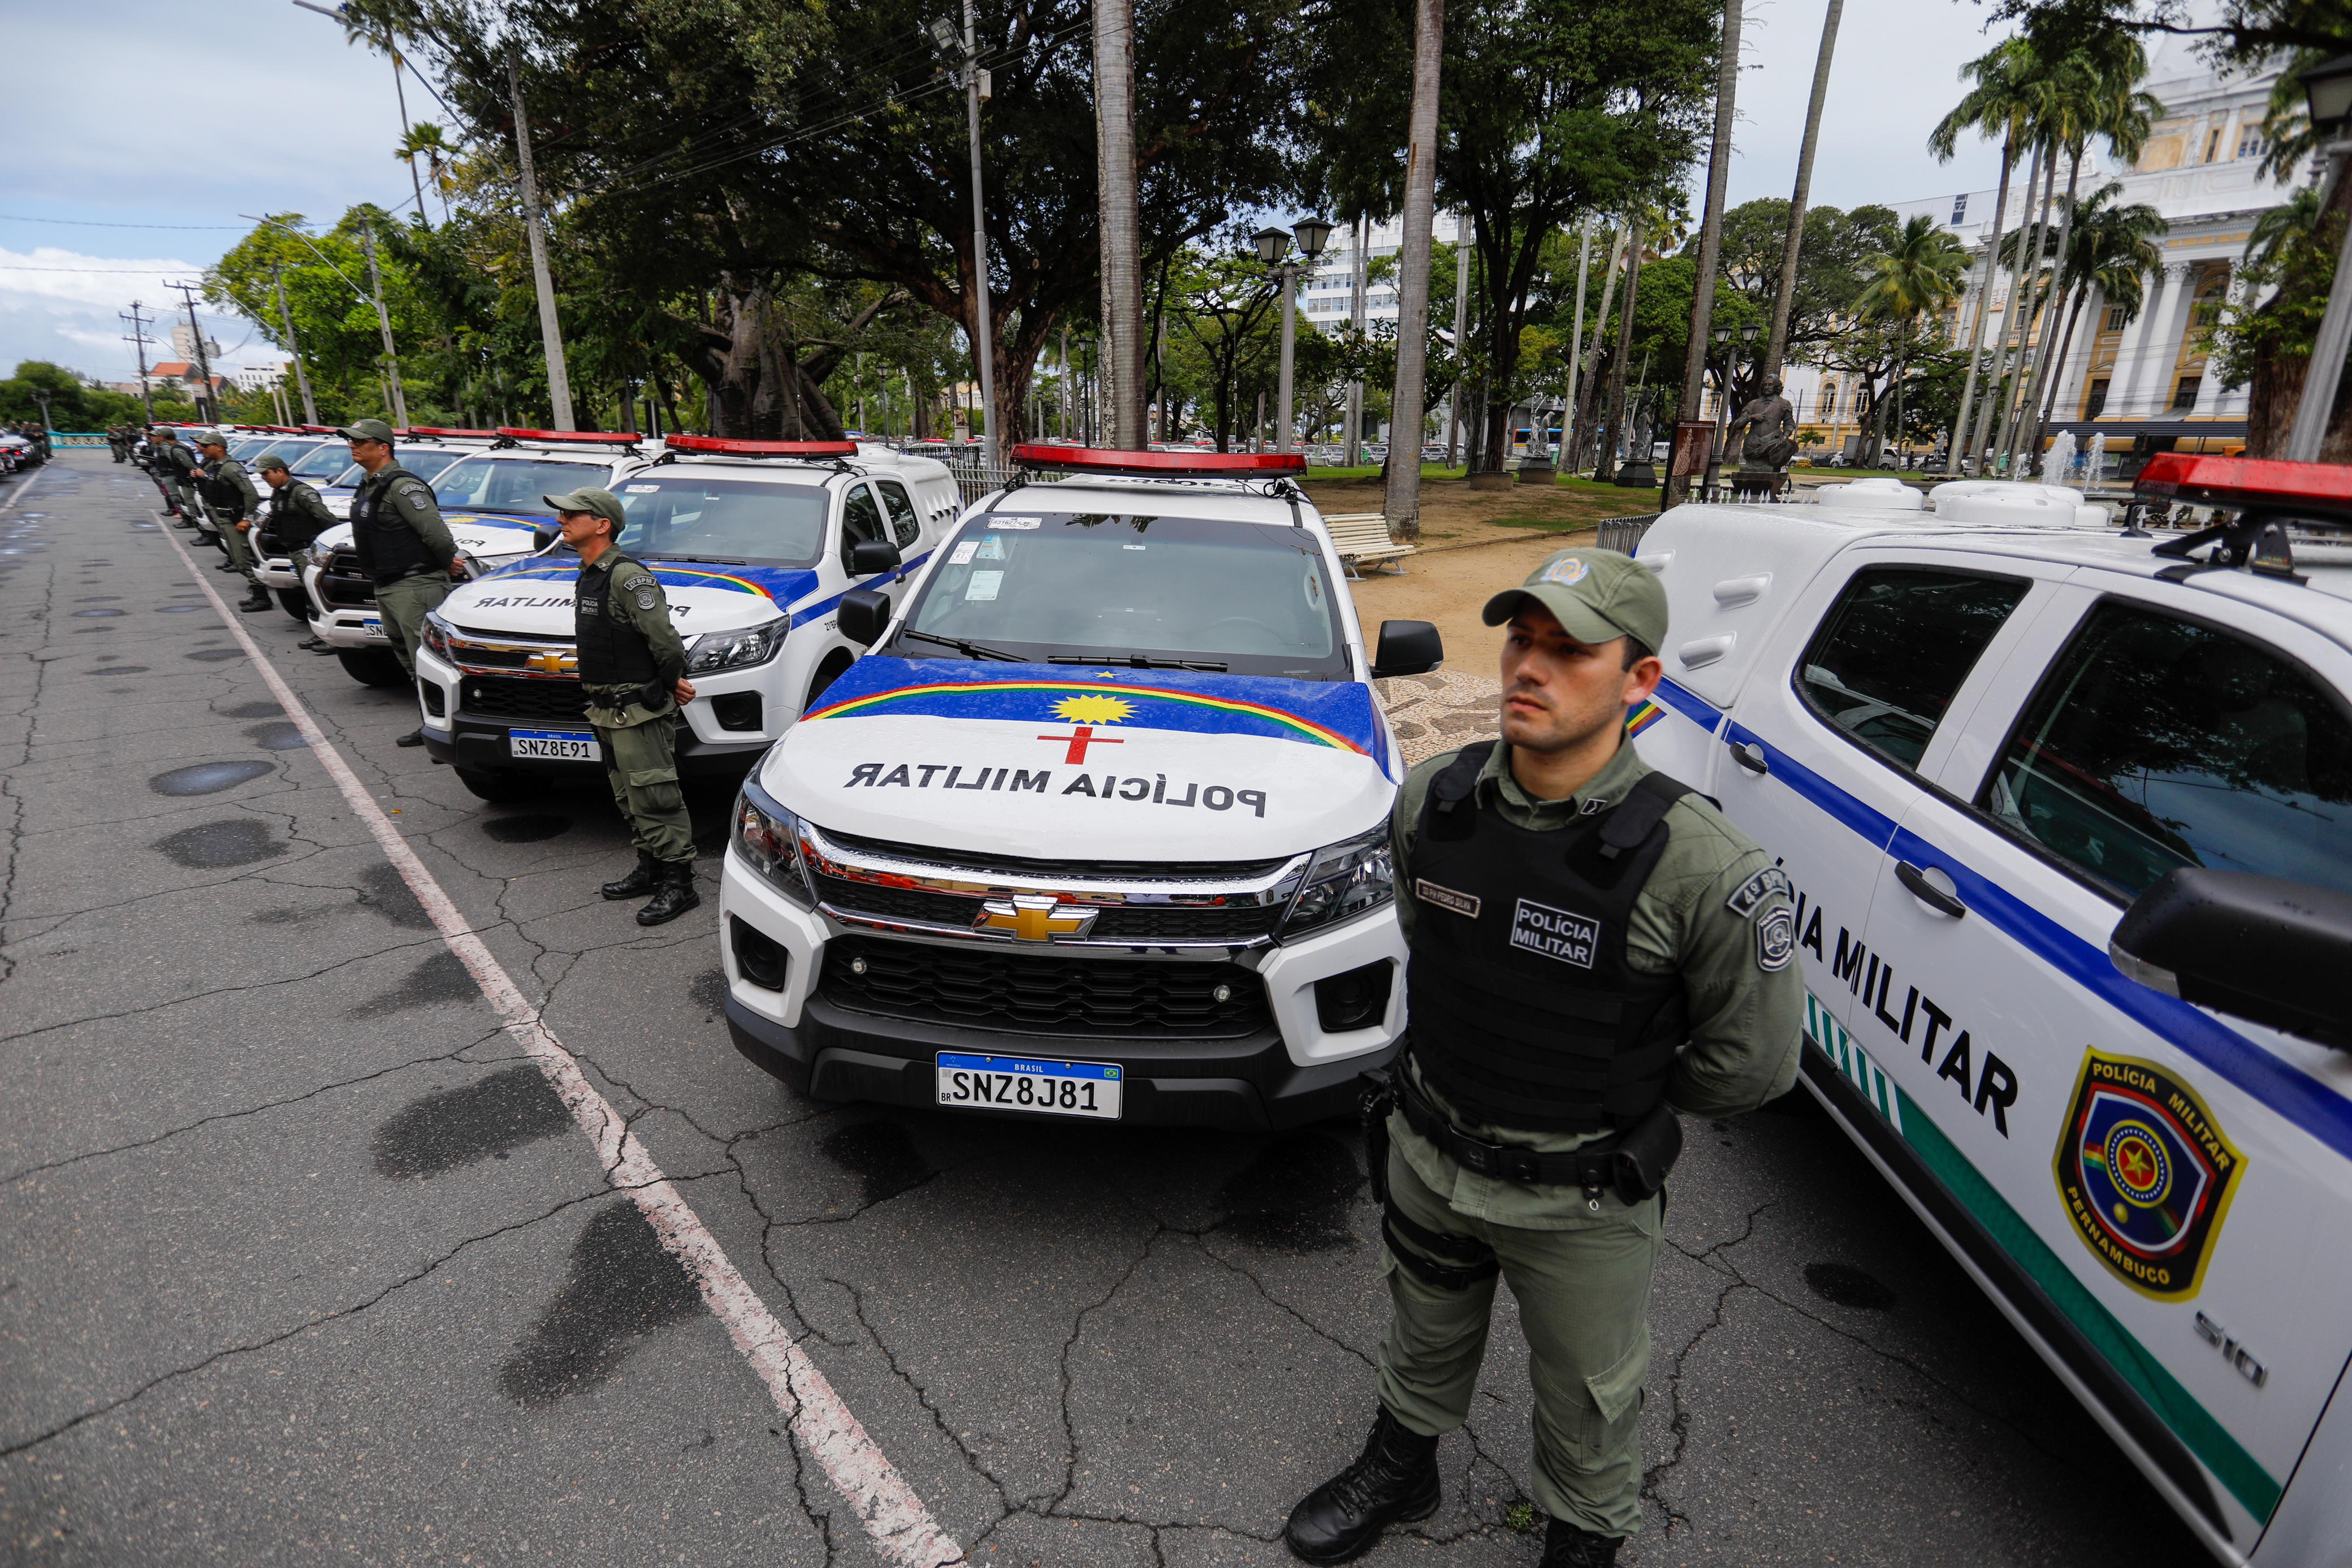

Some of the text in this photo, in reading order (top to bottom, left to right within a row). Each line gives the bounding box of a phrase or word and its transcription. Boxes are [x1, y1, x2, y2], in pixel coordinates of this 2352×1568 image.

[628, 579, 637, 588] 21º
[518, 739, 590, 758] SNZ8E91
[1455, 898, 1471, 911] SILVA
[1743, 883, 1761, 905] 4º
[1518, 908, 1593, 943] POLÍCIA
[1514, 927, 1588, 963] MILITAR
[1832, 926, 2018, 1141] MILITAR
[1014, 1063, 1044, 1073] BRASIL
[941, 1092, 952, 1102] BR
[952, 1072, 1099, 1111] SNZ8J81
[2092, 1063, 2230, 1173] POLÍCIA MILITAR
[2067, 1186, 2171, 1285] PERNAMBUCO
[2194, 1310, 2268, 1389] S10
